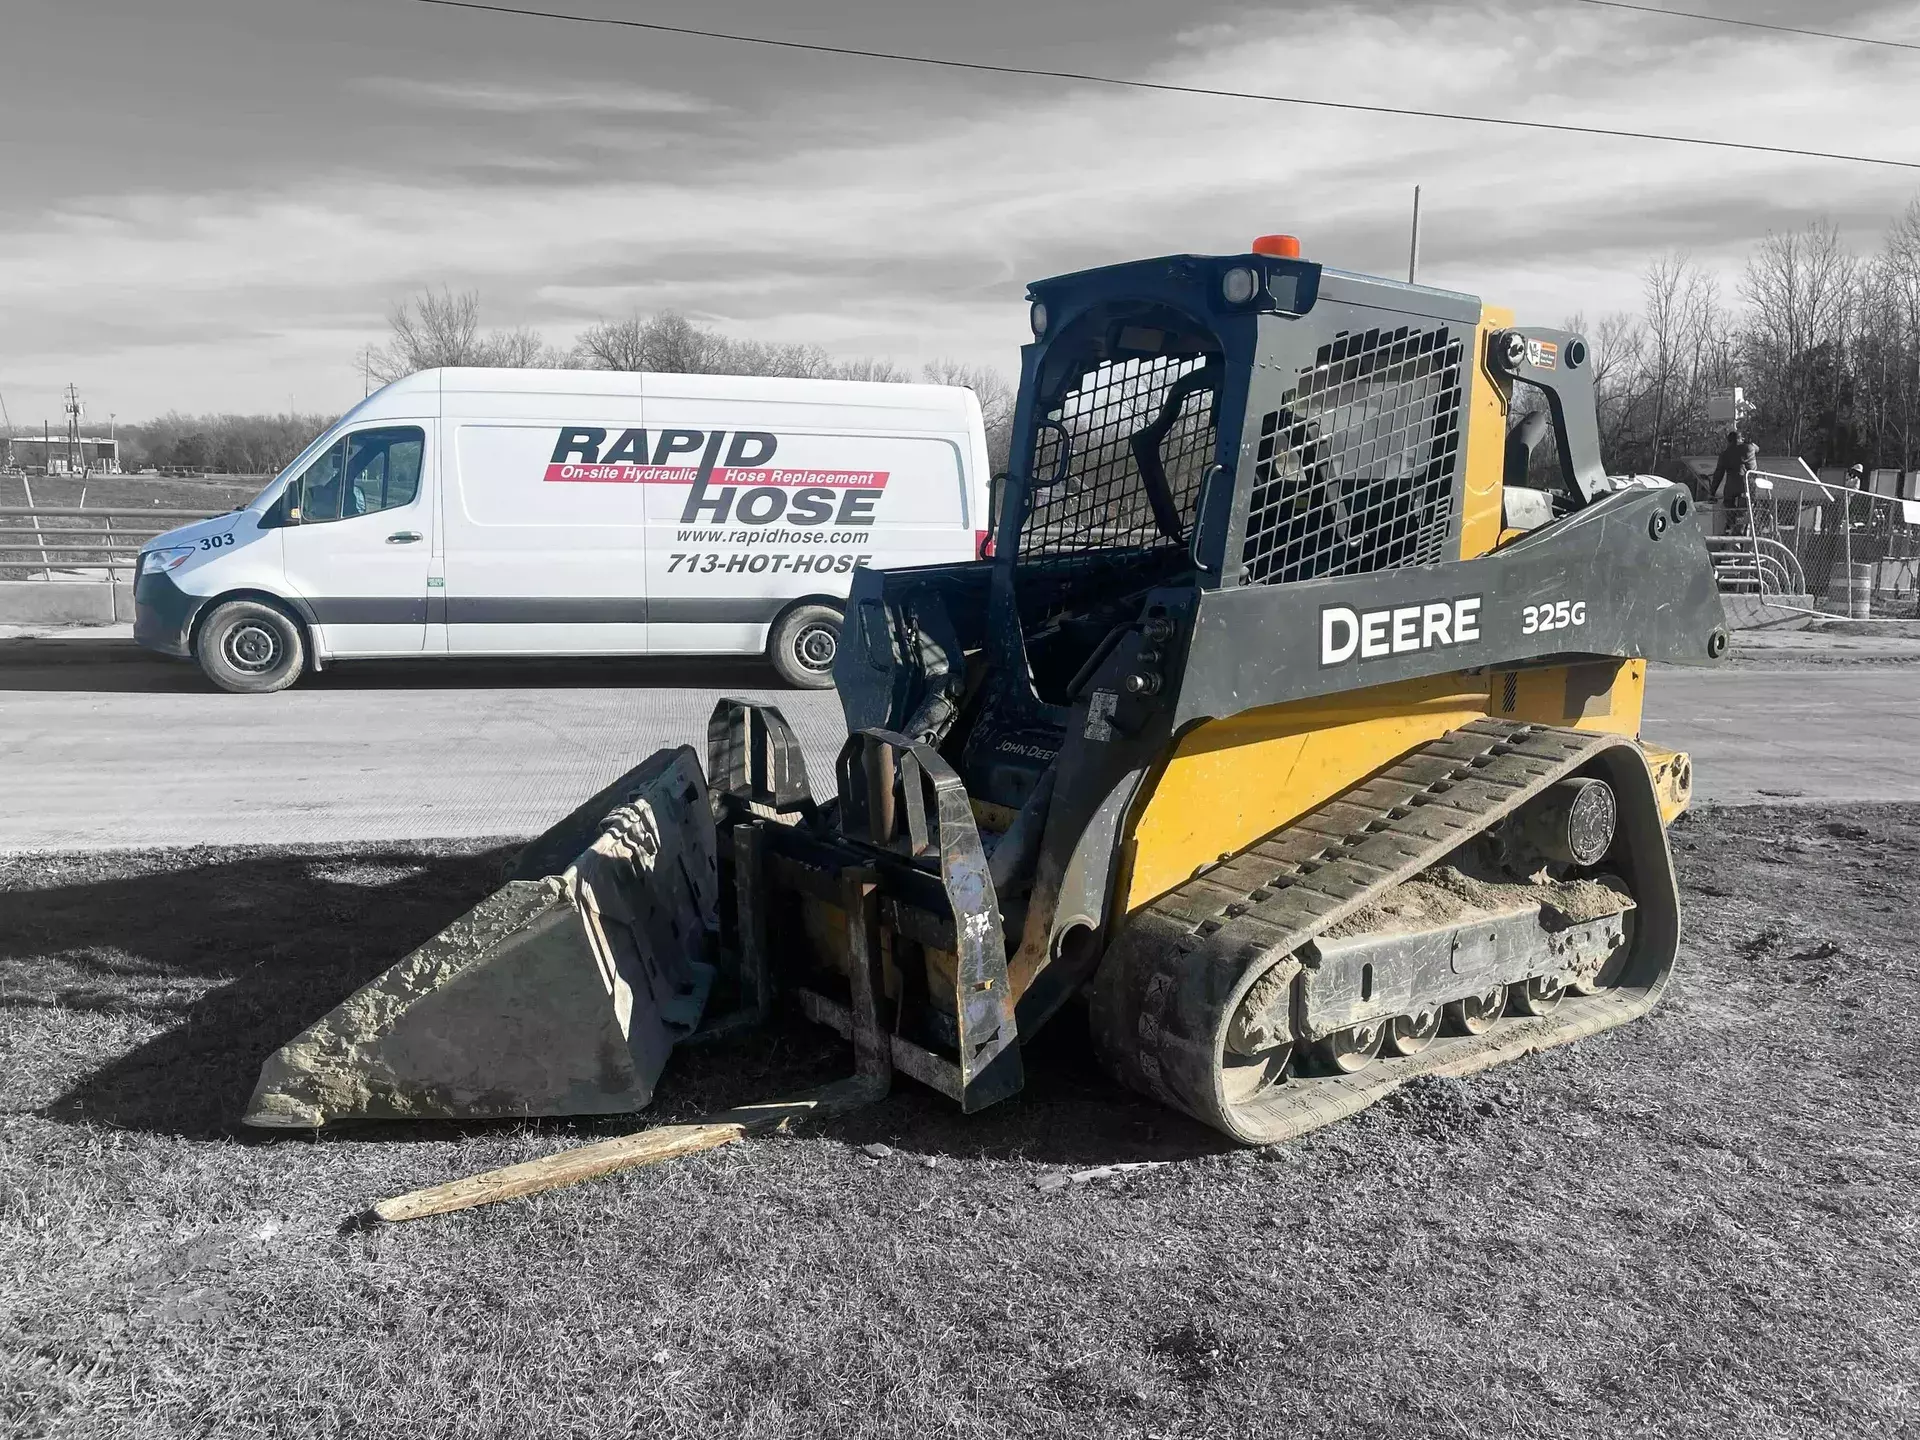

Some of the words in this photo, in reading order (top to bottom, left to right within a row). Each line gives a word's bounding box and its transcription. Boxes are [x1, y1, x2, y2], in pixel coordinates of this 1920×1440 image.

[550, 426, 778, 468] RAPID
[560, 465, 619, 480] On-site
[622, 467, 698, 483] Hydraulic
[724, 469, 766, 482] Hose
[770, 470, 875, 486] Replacement
[680, 486, 884, 526] HOSE
[200, 533, 235, 551] 303
[676, 528, 869, 546] www.rapidhose.com
[667, 553, 873, 574] 713-HOT-HOSE
[1521, 600, 1586, 635] 325G
[1321, 596, 1482, 666] DEERE
[995, 739, 1029, 755] JOHN
[1026, 745, 1061, 761] DEER
